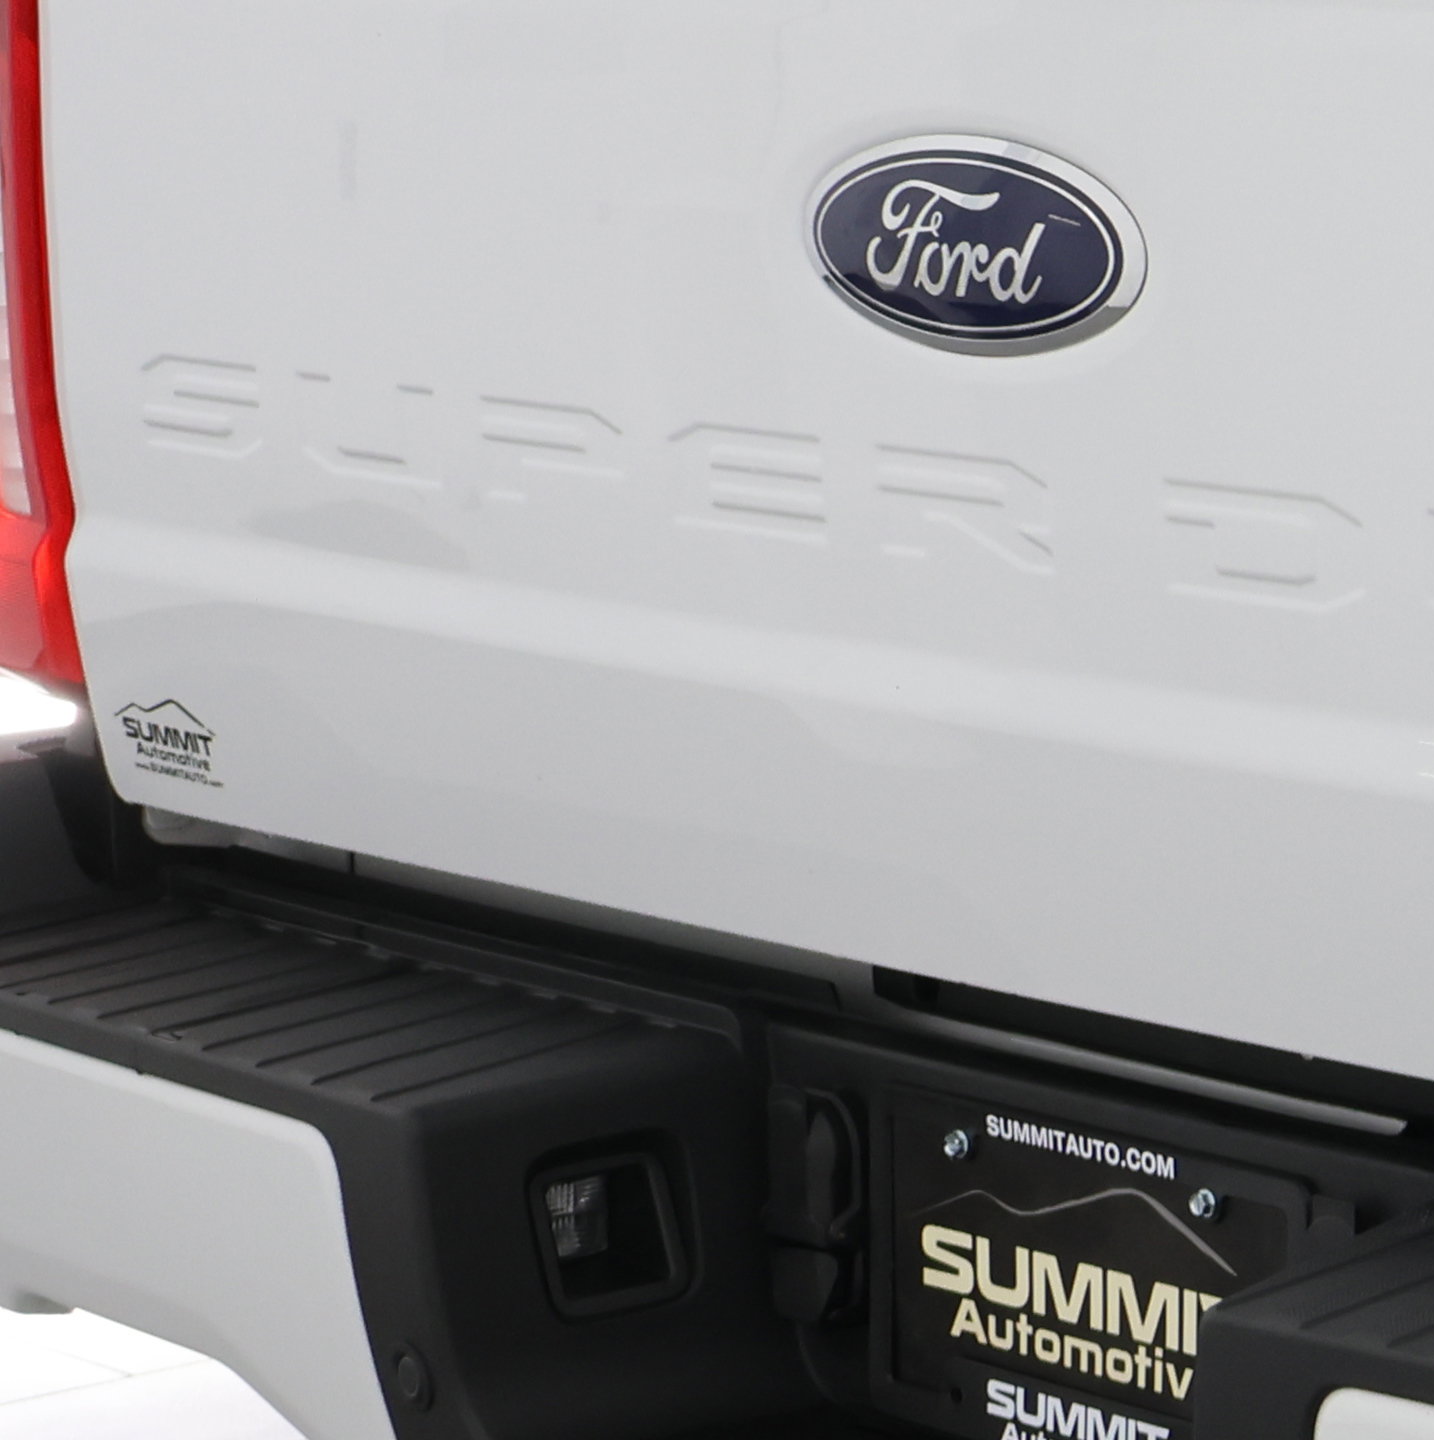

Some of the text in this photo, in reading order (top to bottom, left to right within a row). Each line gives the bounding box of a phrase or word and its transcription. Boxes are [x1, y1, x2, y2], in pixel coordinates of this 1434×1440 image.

[866, 178, 1046, 304] Ford
[140, 352, 1055, 576] SUPER
[122, 716, 213, 757] SUMMIT
[136, 741, 211, 772] Automotive
[985, 1113, 1176, 1180] SUMMITAUTO.COM
[921, 1224, 1224, 1357] SUMMI
[950, 1297, 1194, 1401] Automotiv
